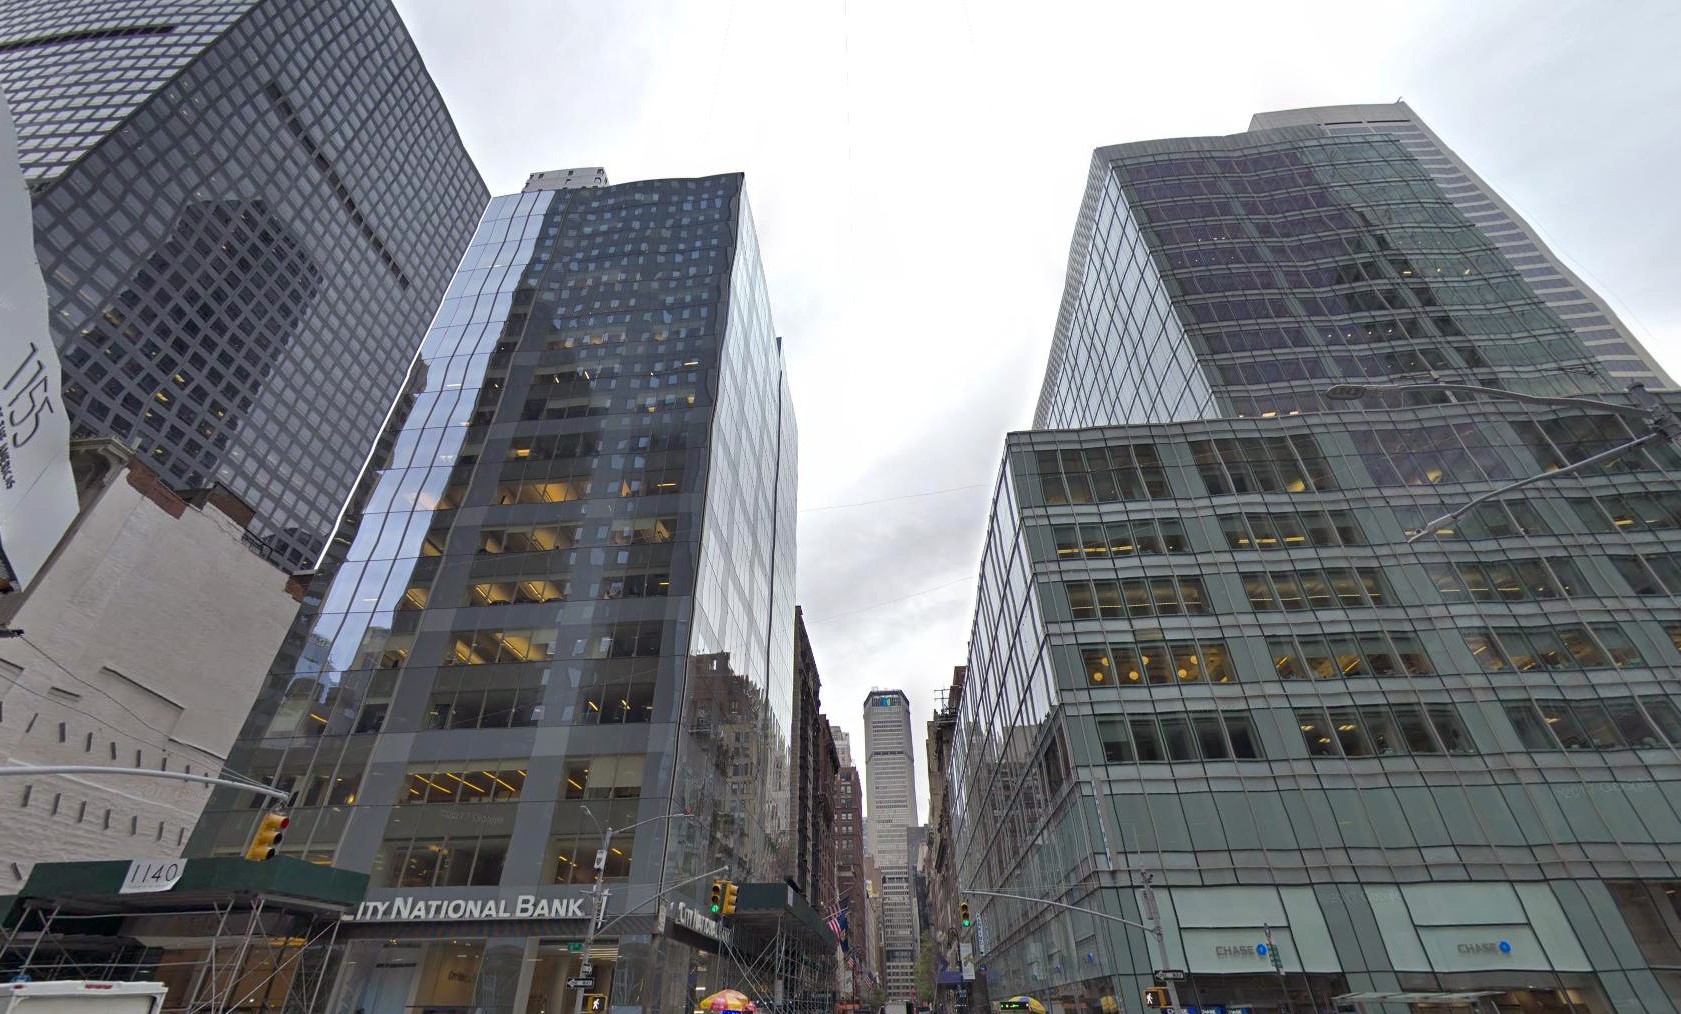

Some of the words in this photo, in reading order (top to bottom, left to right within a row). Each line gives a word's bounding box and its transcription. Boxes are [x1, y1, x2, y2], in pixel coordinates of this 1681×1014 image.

[131, 863, 179, 883] 1140
[342, 901, 390, 921] ITY
[391, 897, 511, 920] NATIONAL
[515, 895, 584, 918] BANK
[1216, 945, 1255, 956] CHASE
[1457, 943, 1498, 953] CHASE
